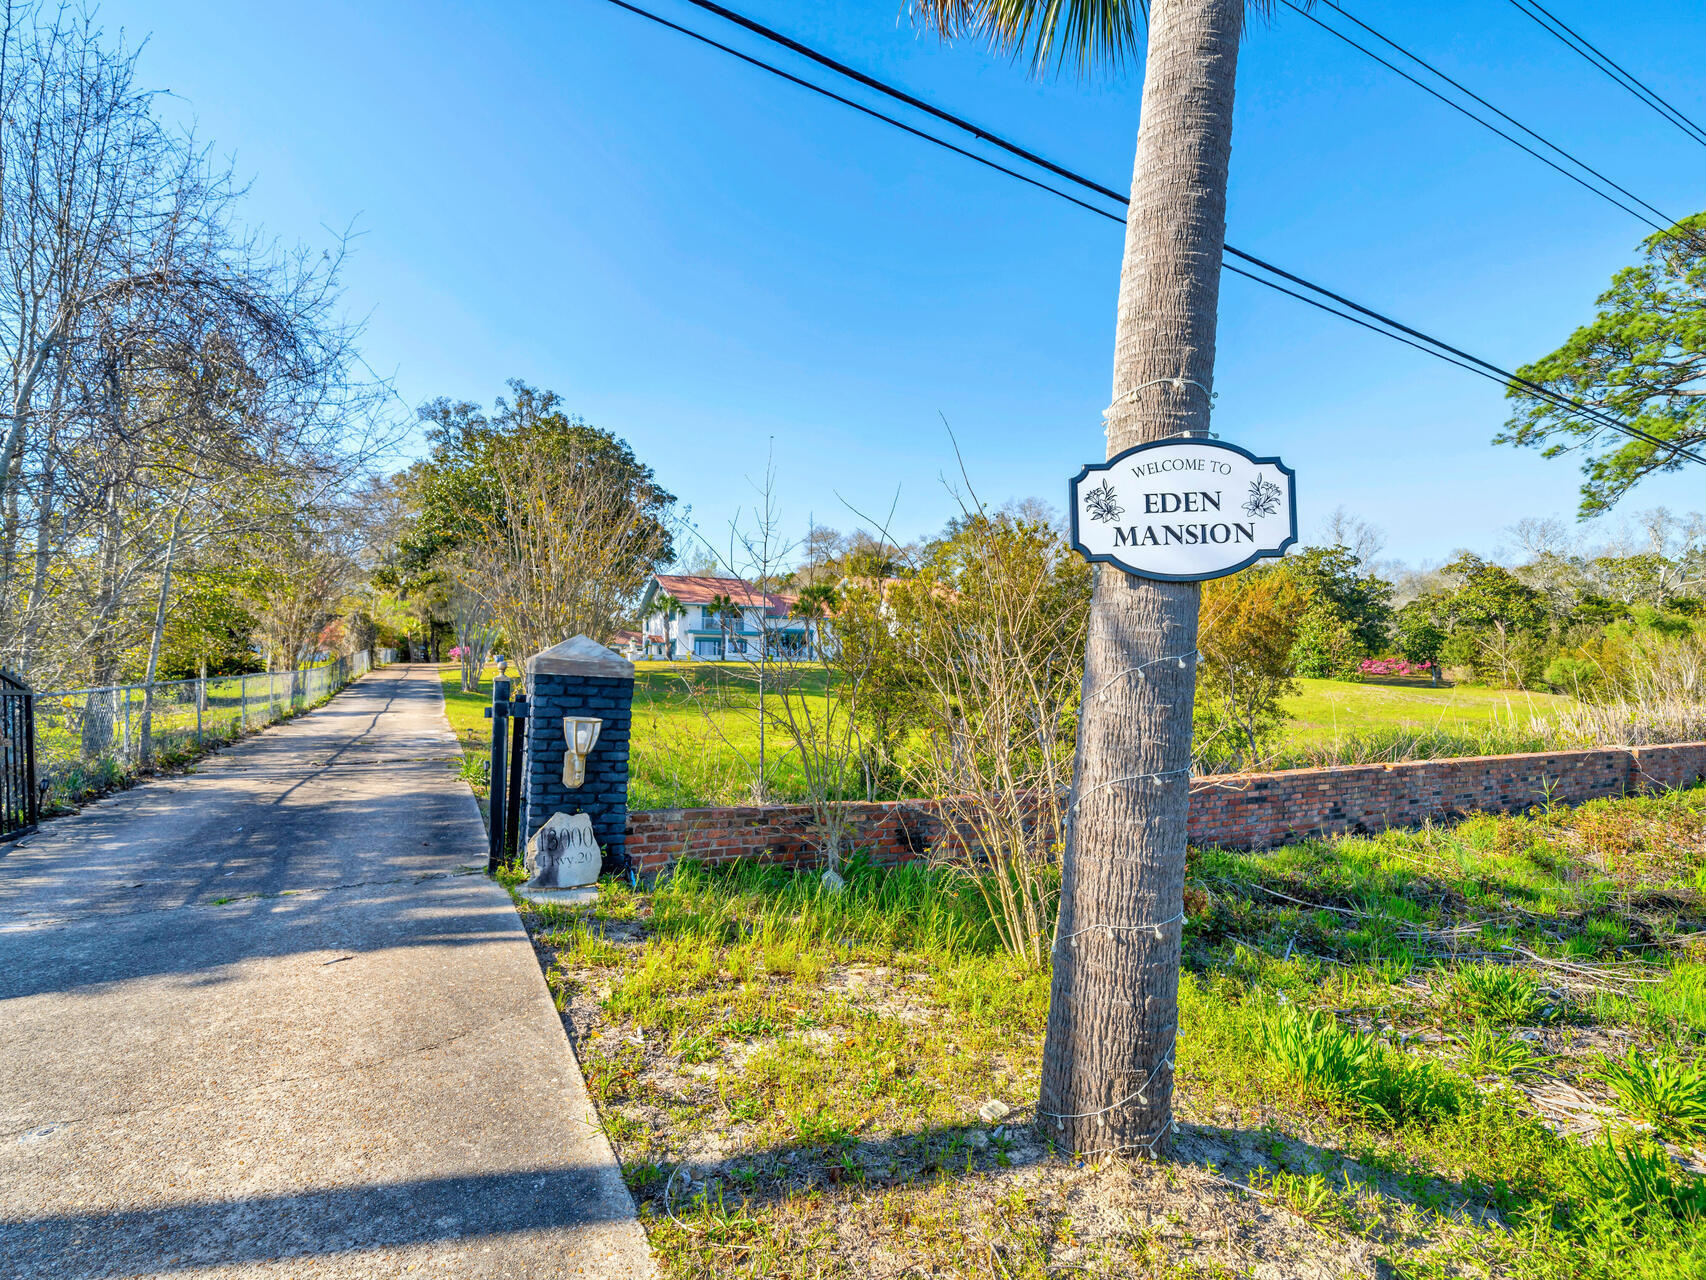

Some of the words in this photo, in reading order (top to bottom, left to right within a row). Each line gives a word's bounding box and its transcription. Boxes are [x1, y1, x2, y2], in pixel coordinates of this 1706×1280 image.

[1131, 458, 1205, 478] WELCOME
[1210, 460, 1232, 475] TO
[1143, 491, 1222, 514] EDEN
[1113, 522, 1255, 547] MANSION
[540, 826, 593, 851] 13000
